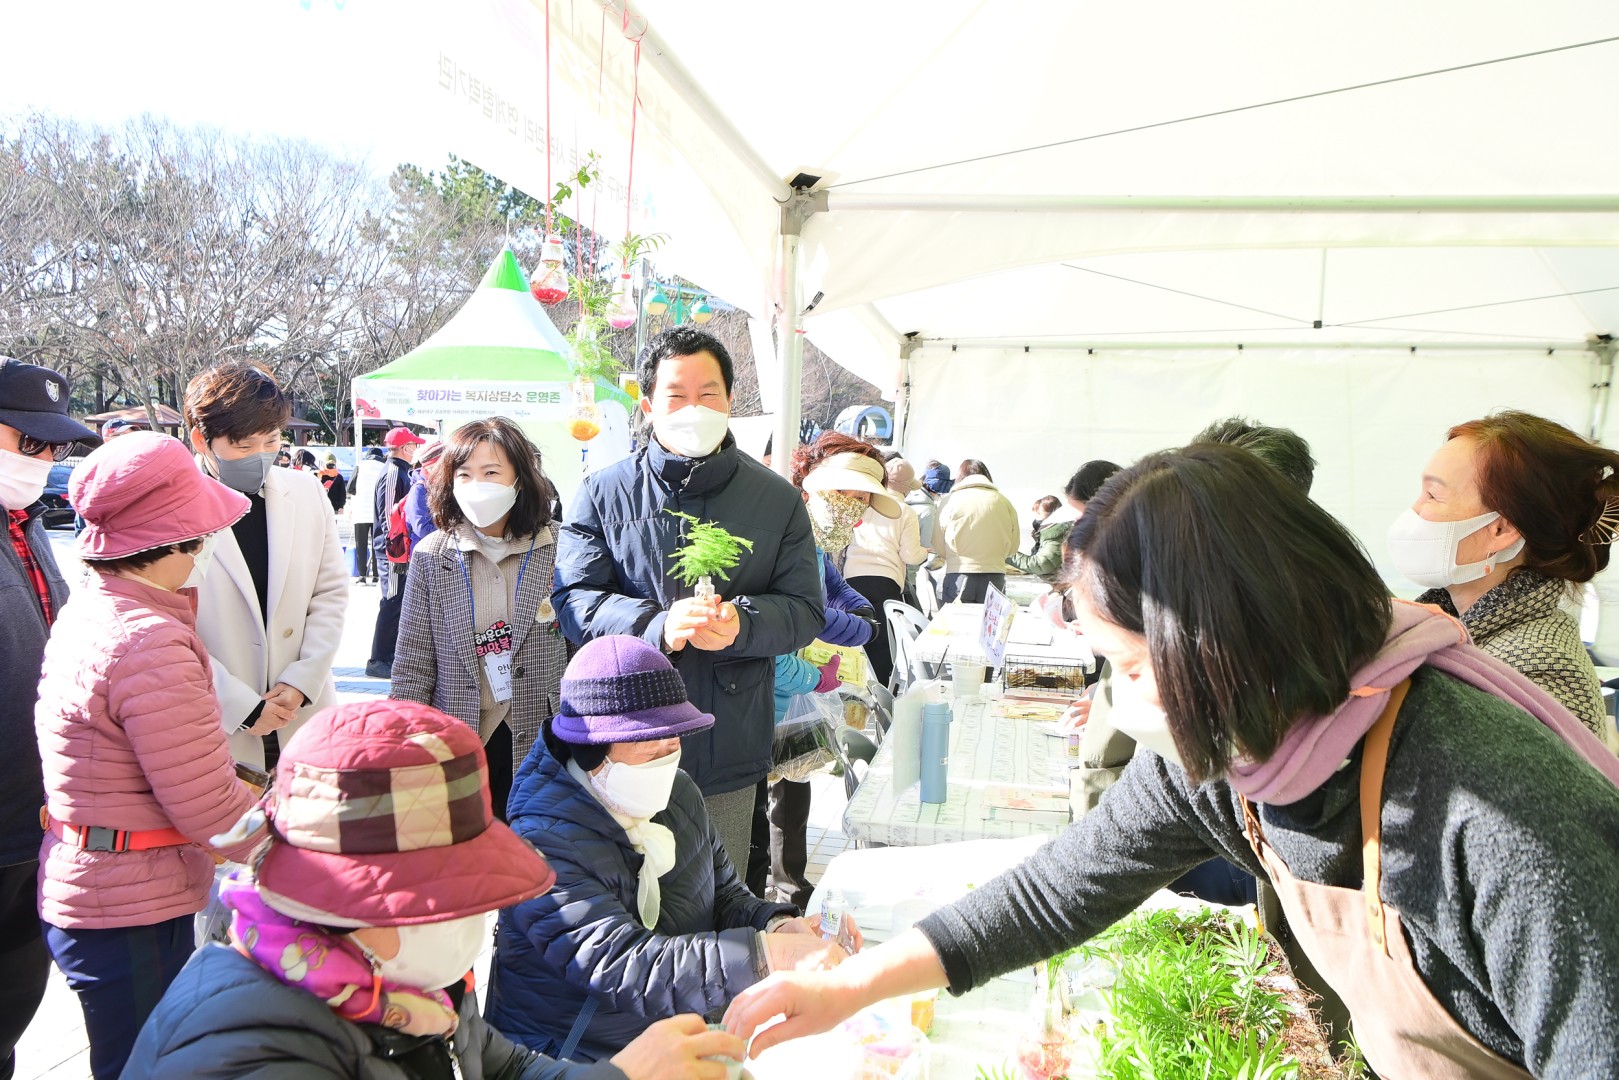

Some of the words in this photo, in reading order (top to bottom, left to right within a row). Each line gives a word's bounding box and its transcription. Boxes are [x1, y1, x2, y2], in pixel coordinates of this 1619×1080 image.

[416, 389, 462, 402] 찾아가는
[465, 390, 522, 403] 복지상담소
[525, 391, 561, 404] 운영존
[474, 624, 512, 645] 해운대구
[476, 636, 512, 657] 희망복
